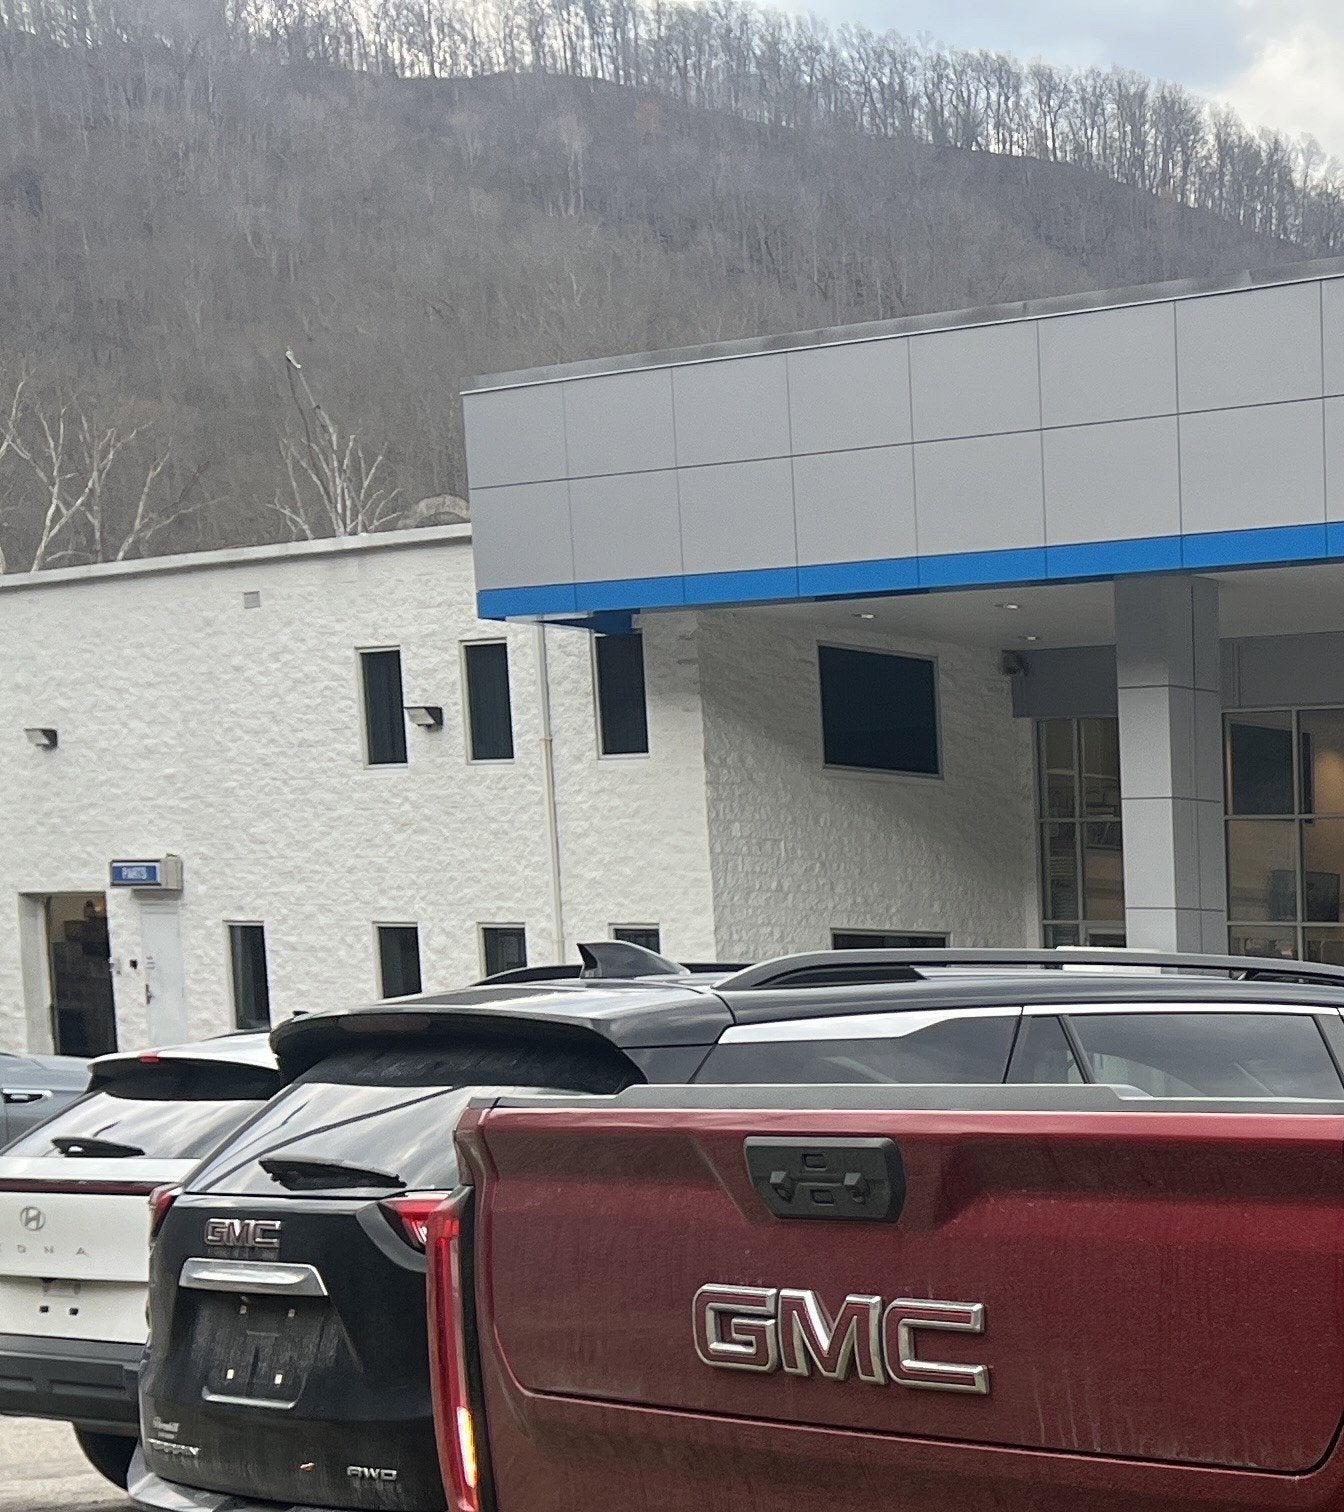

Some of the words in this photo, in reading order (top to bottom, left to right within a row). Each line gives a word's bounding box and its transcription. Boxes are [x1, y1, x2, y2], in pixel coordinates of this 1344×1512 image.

[204, 1218, 281, 1248] GMC
[692, 1283, 991, 1395] GMC
[347, 1465, 397, 1481] AWD
